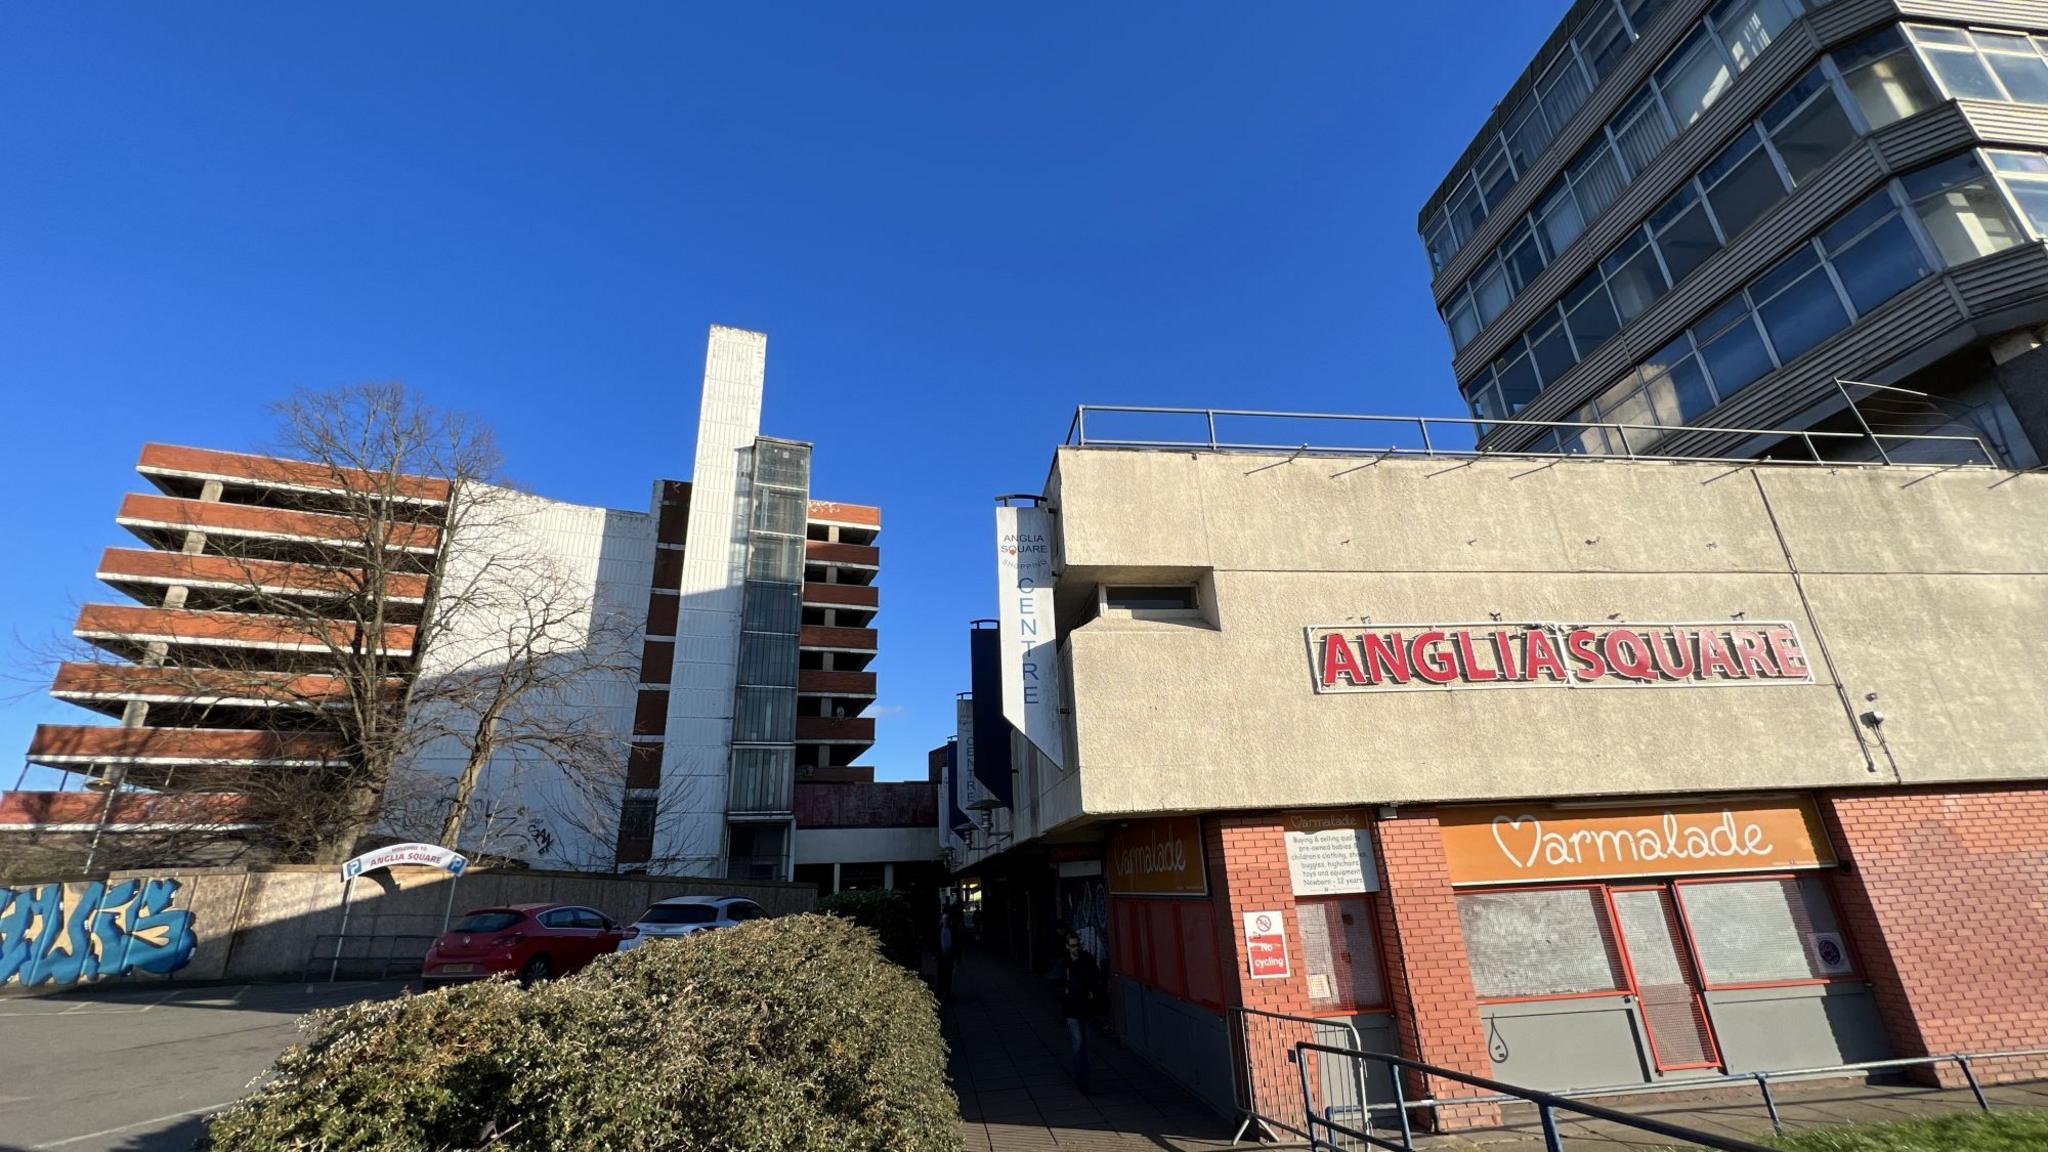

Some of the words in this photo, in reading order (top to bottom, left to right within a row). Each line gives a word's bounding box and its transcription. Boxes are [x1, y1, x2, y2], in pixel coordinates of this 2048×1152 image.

[1003, 534, 1044, 543] ANGLIA
[1001, 545, 1049, 555] SQUARE
[1002, 560, 1048, 569] SHOPPING
[1017, 577, 1040, 704] CENTRE
[1323, 630, 1567, 684] ANGLIA
[1567, 629, 1809, 680] SQUARE
[967, 736, 976, 803] CENTRE
[1320, 834, 1340, 843] selling
[370, 854, 405, 867] ANGLIA
[407, 853, 442, 865] SQUARE
[1330, 868, 1361, 877] equipment
[1346, 877, 1364, 885] years
[1261, 944, 1272, 952] No
[1254, 957, 1284, 969] cycling
